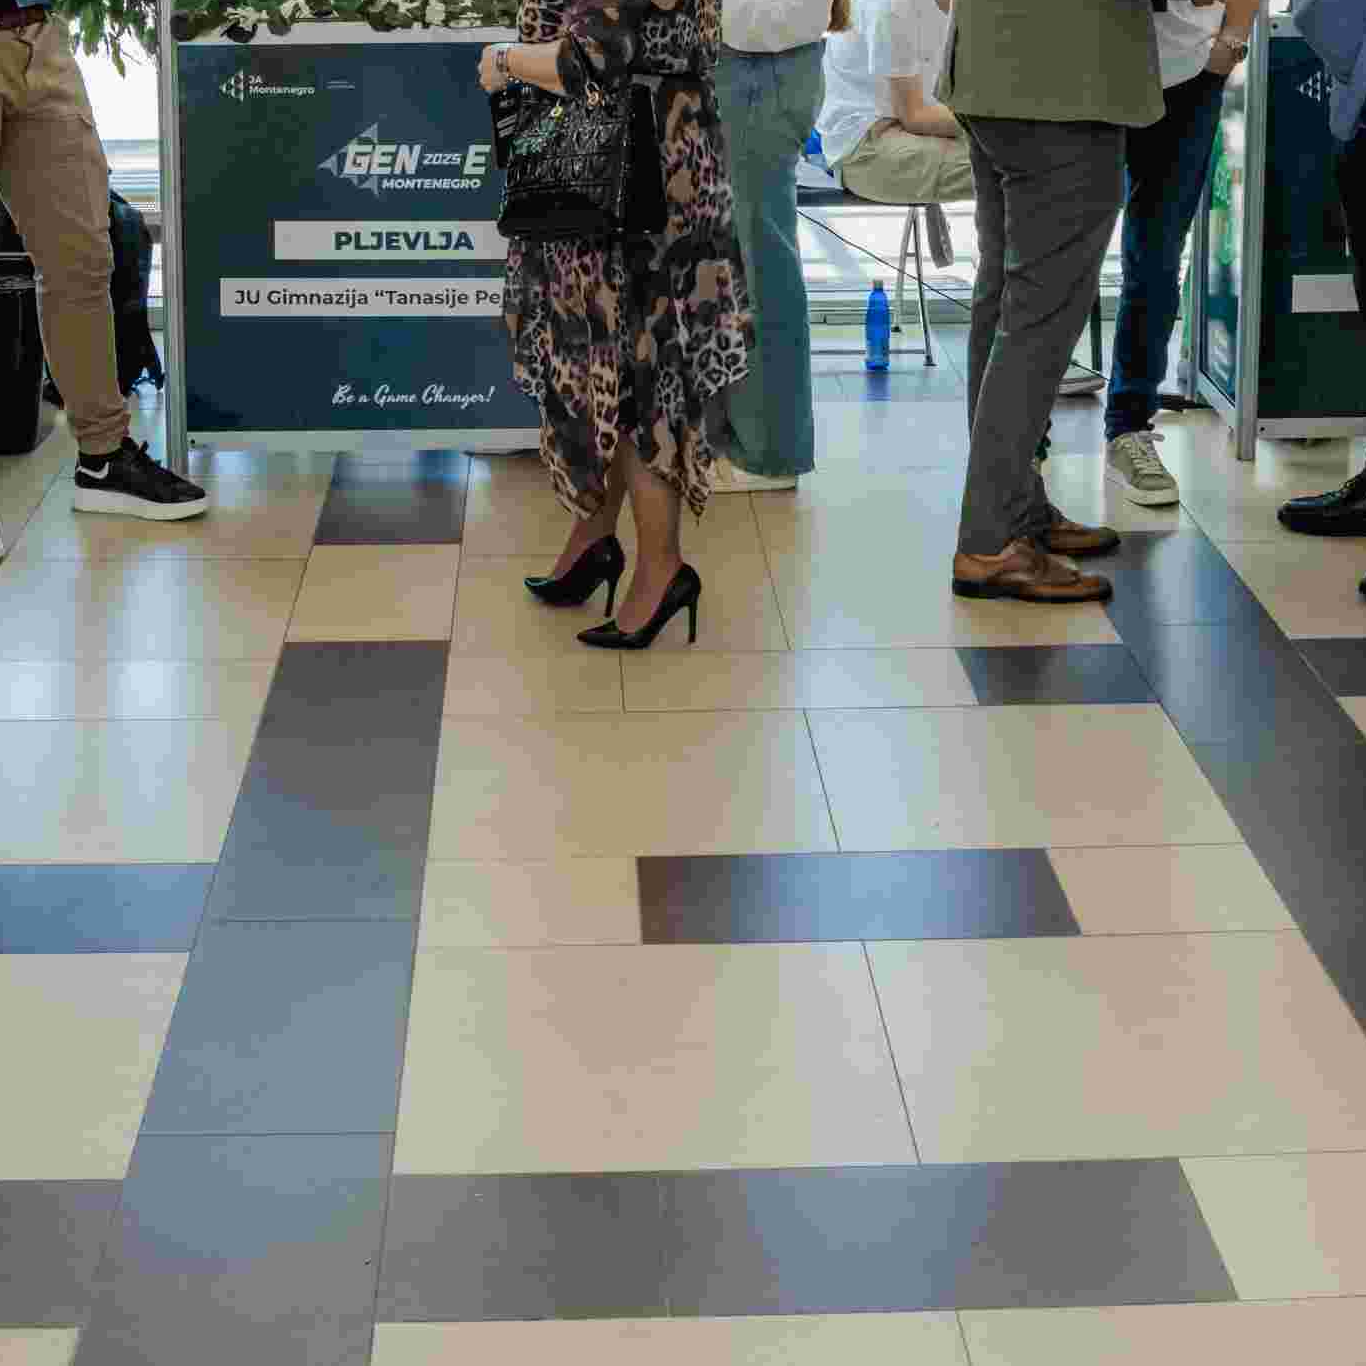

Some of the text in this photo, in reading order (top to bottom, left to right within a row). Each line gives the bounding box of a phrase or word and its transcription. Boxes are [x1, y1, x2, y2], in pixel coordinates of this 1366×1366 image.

[343, 144, 491, 175] GEN 2025 E
[382, 178, 482, 190] MONTENEGRO
[334, 231, 475, 251] PLJEVLJA
[234, 289, 260, 305] JU
[267, 288, 369, 308] Gimnazija
[332, 382, 496, 410] Be a Game Changer!
